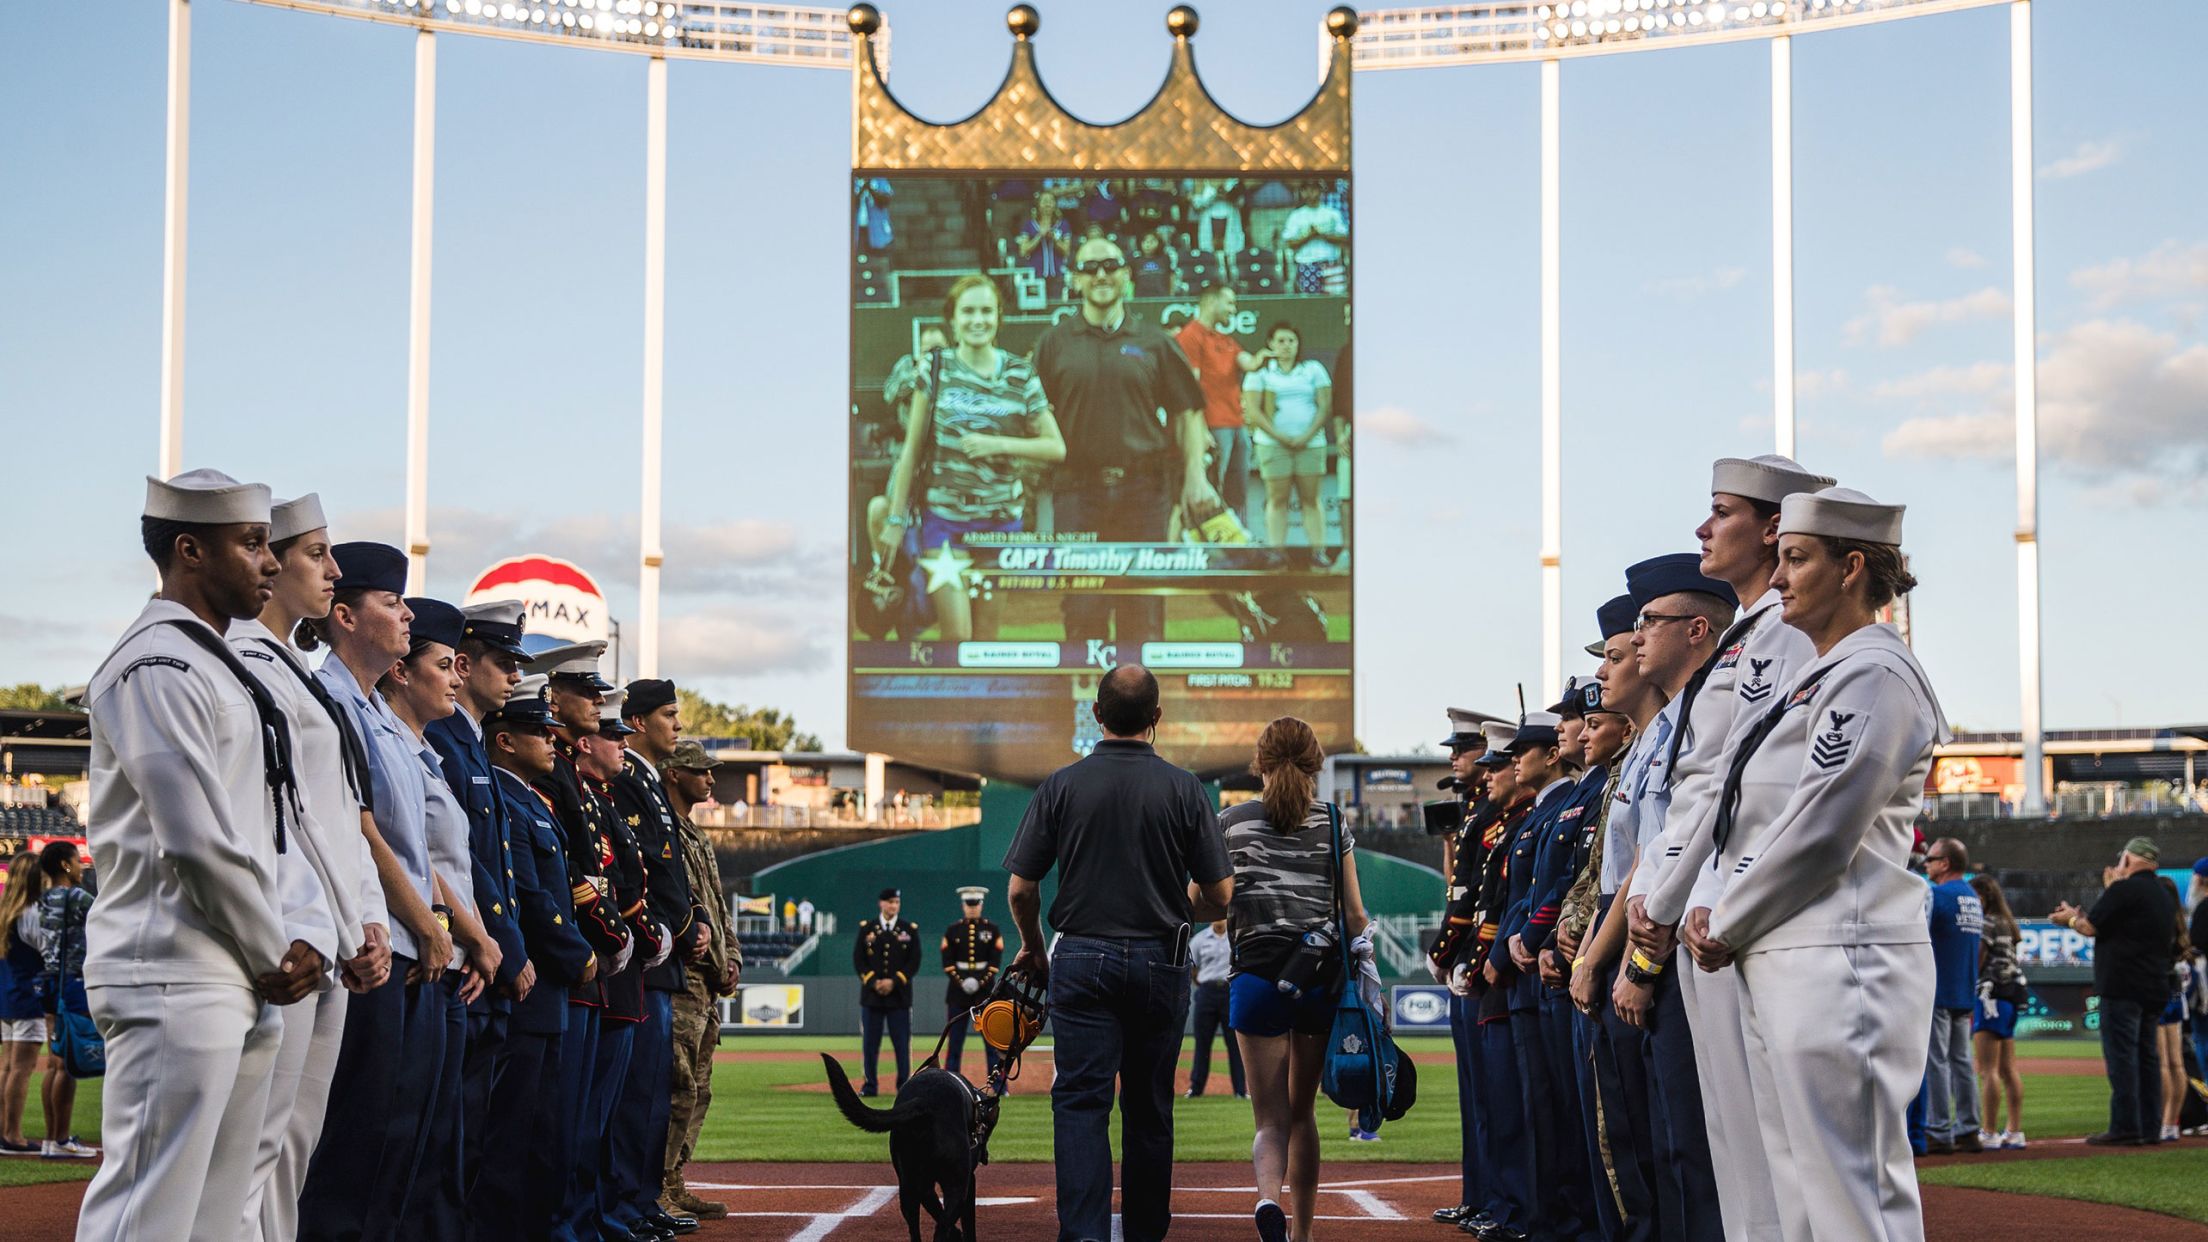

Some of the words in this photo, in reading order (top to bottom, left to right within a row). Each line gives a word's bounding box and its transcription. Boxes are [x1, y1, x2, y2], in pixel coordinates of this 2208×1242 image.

[998, 548, 1050, 569] CAPT
[1052, 547, 1135, 575] Timothy
[1136, 547, 1209, 570] Hornik
[1071, 576, 1106, 589] ARMY
[1086, 639, 1117, 671] KC
